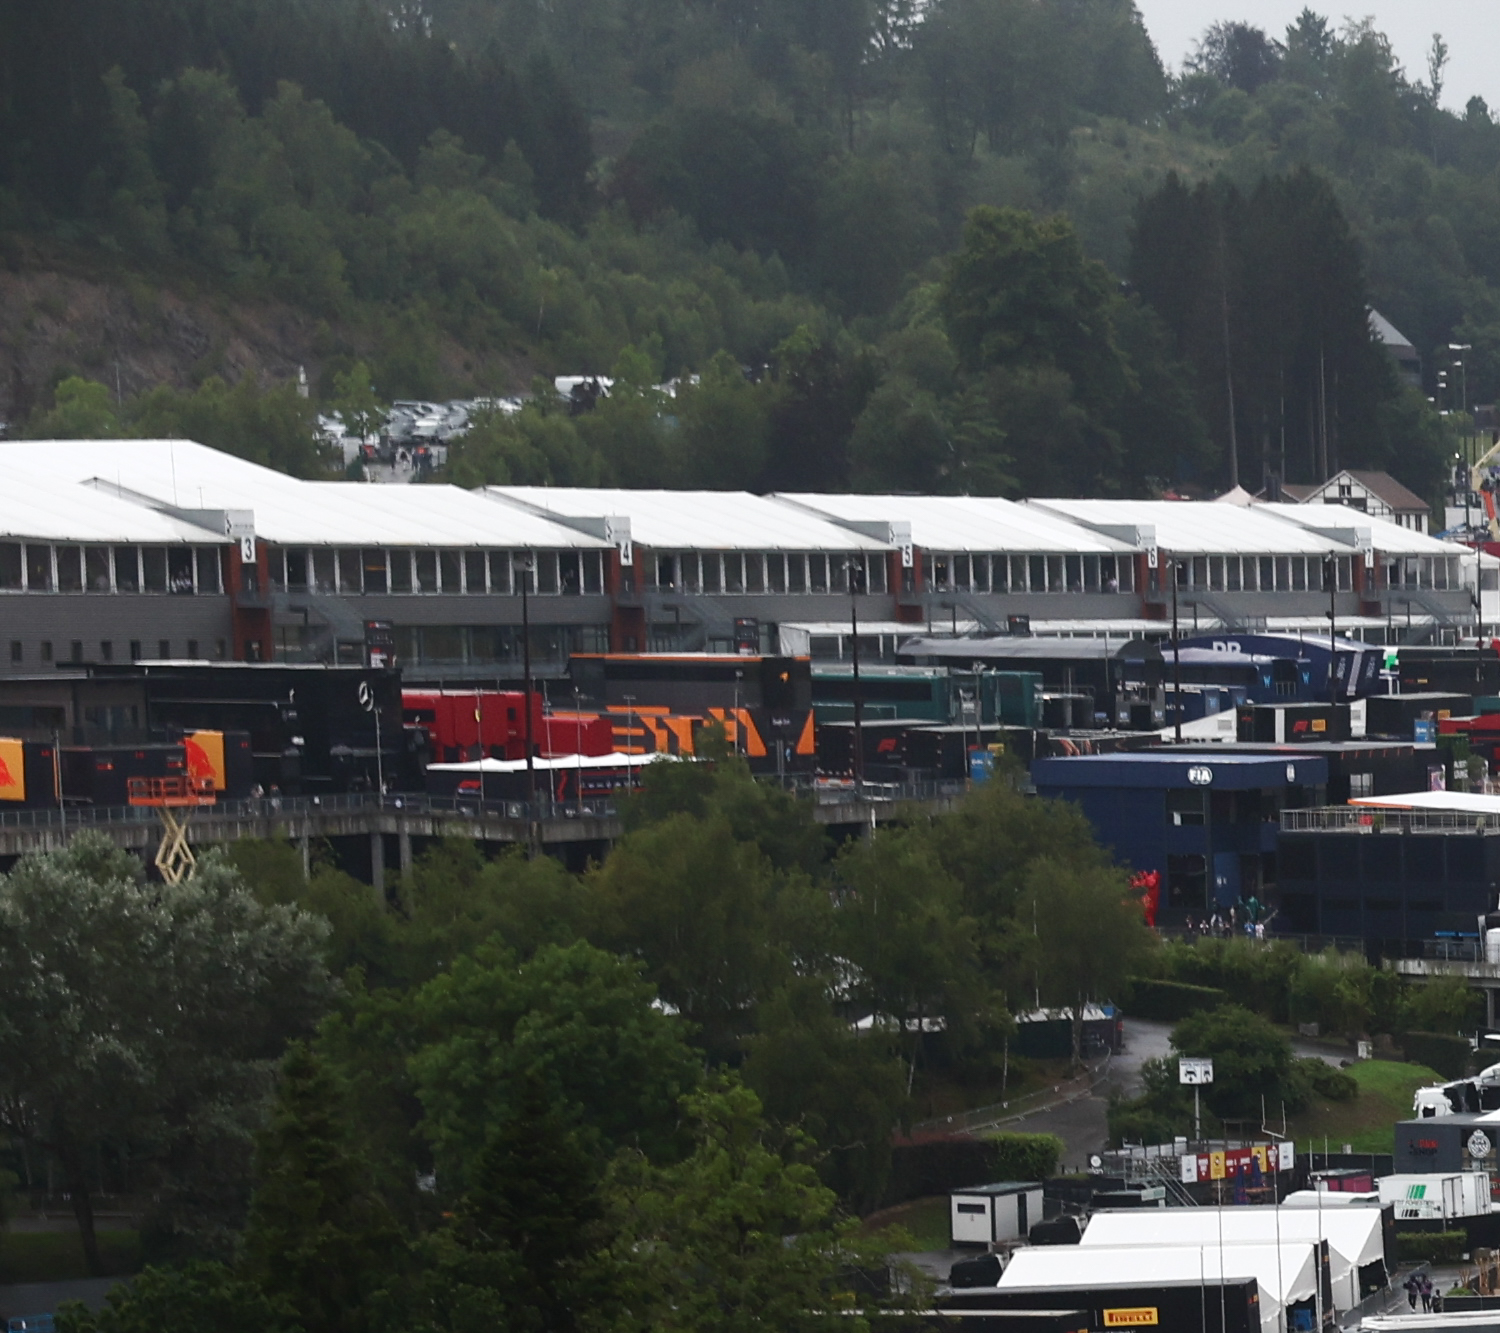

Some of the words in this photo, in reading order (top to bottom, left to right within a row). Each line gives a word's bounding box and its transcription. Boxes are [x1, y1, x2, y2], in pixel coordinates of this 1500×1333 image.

[245, 538, 252, 560] 3
[623, 544, 629, 560] 4
[904, 549, 910, 565] 5
[1150, 551, 1156, 566] 6
[1366, 550, 1372, 564] 7
[1107, 1312, 1154, 1323] PIRELLI
